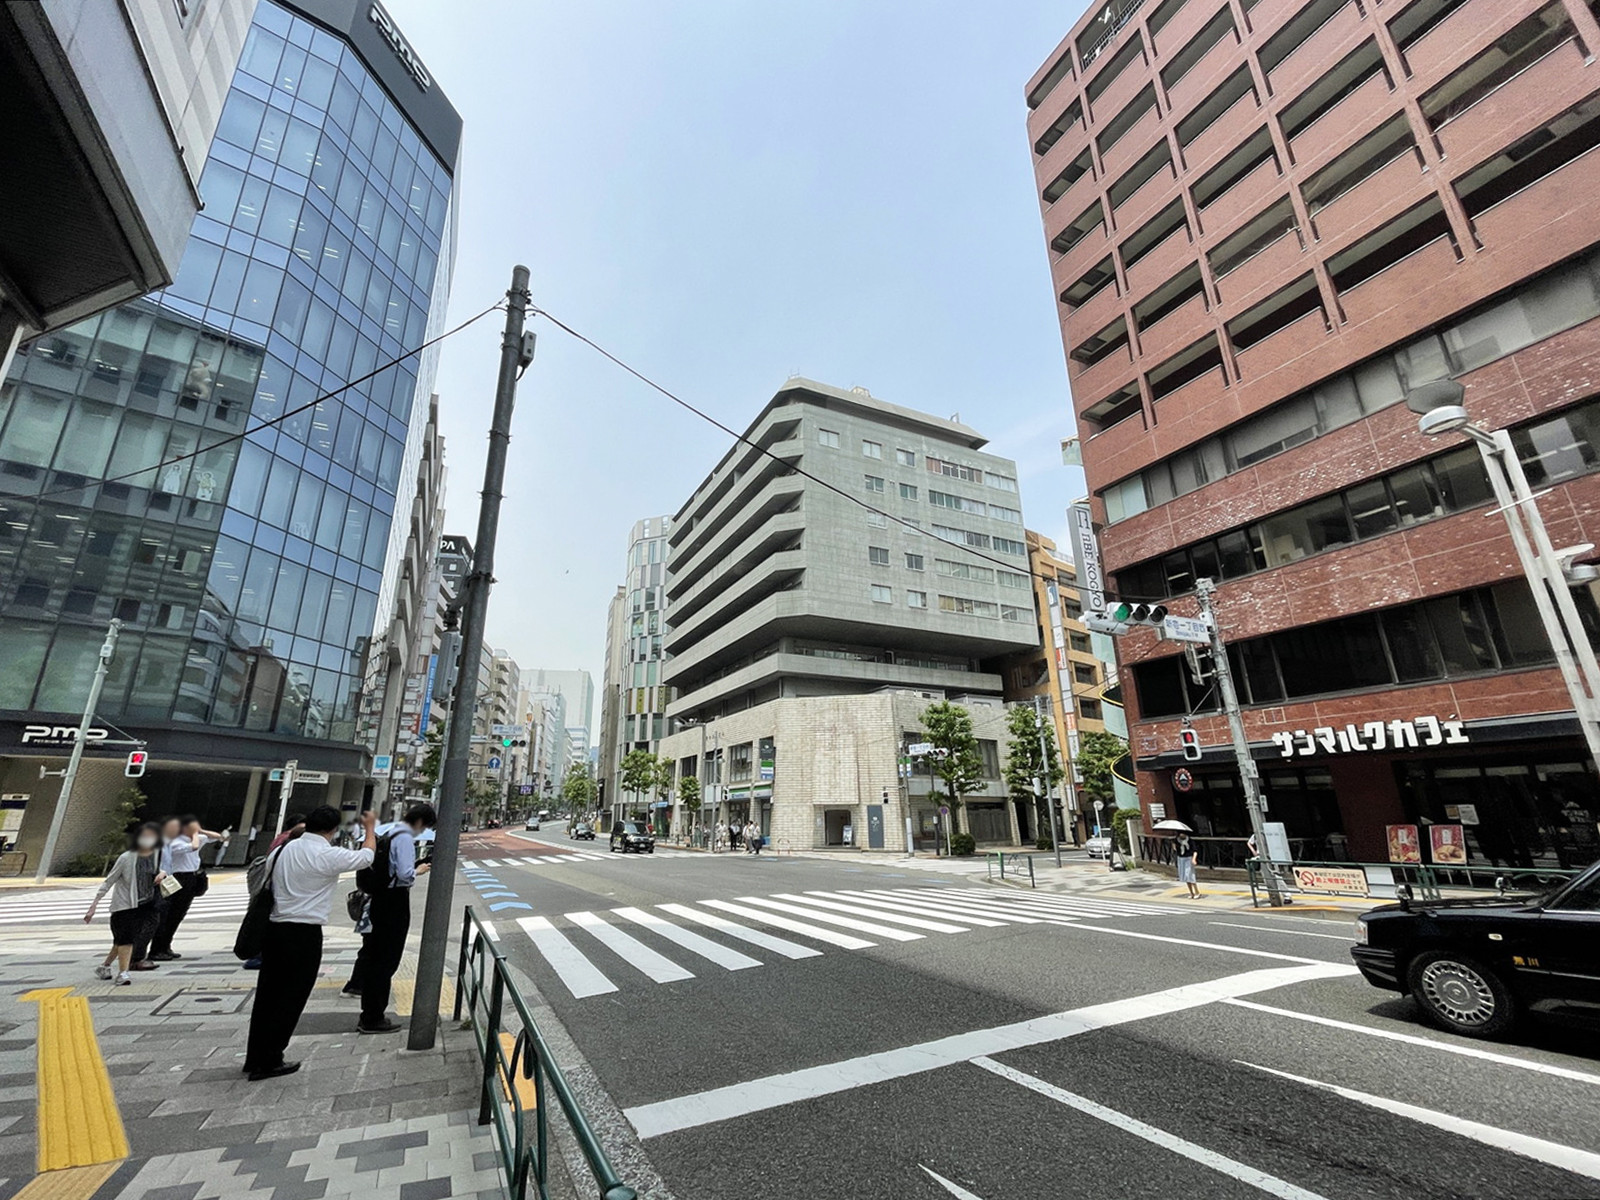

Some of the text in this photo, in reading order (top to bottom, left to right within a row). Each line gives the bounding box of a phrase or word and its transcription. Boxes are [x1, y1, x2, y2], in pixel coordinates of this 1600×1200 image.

[1087, 562, 1102, 608] KOGYO
[1271, 715, 1469, 757] サンマルクカフェ
